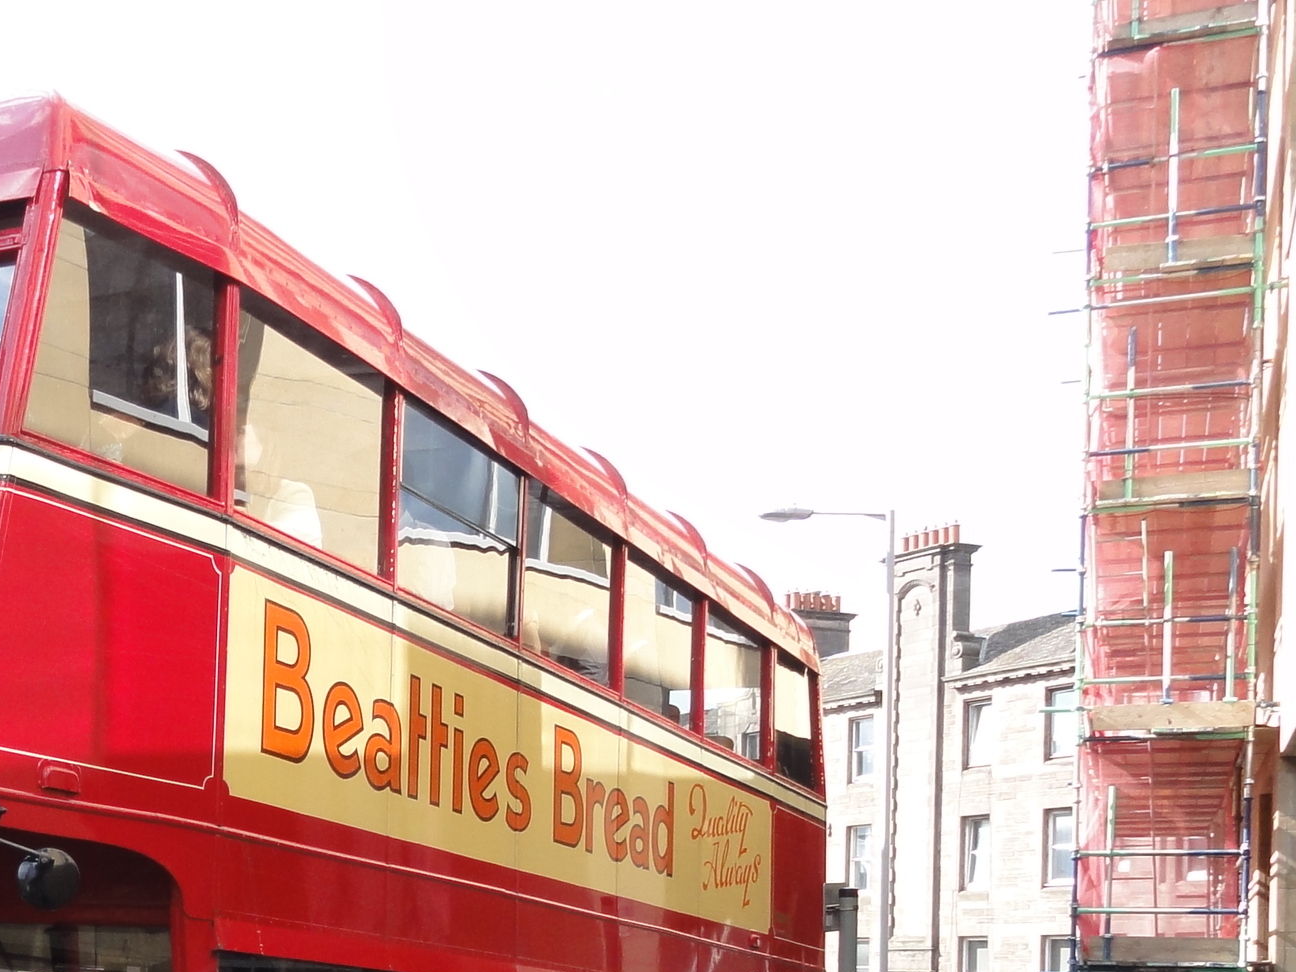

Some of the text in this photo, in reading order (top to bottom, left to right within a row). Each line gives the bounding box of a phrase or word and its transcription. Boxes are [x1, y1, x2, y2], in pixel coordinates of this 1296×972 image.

[260, 598, 675, 879] Beatties Bread
[688, 783, 755, 857] Quality
[702, 852, 763, 908] Always
